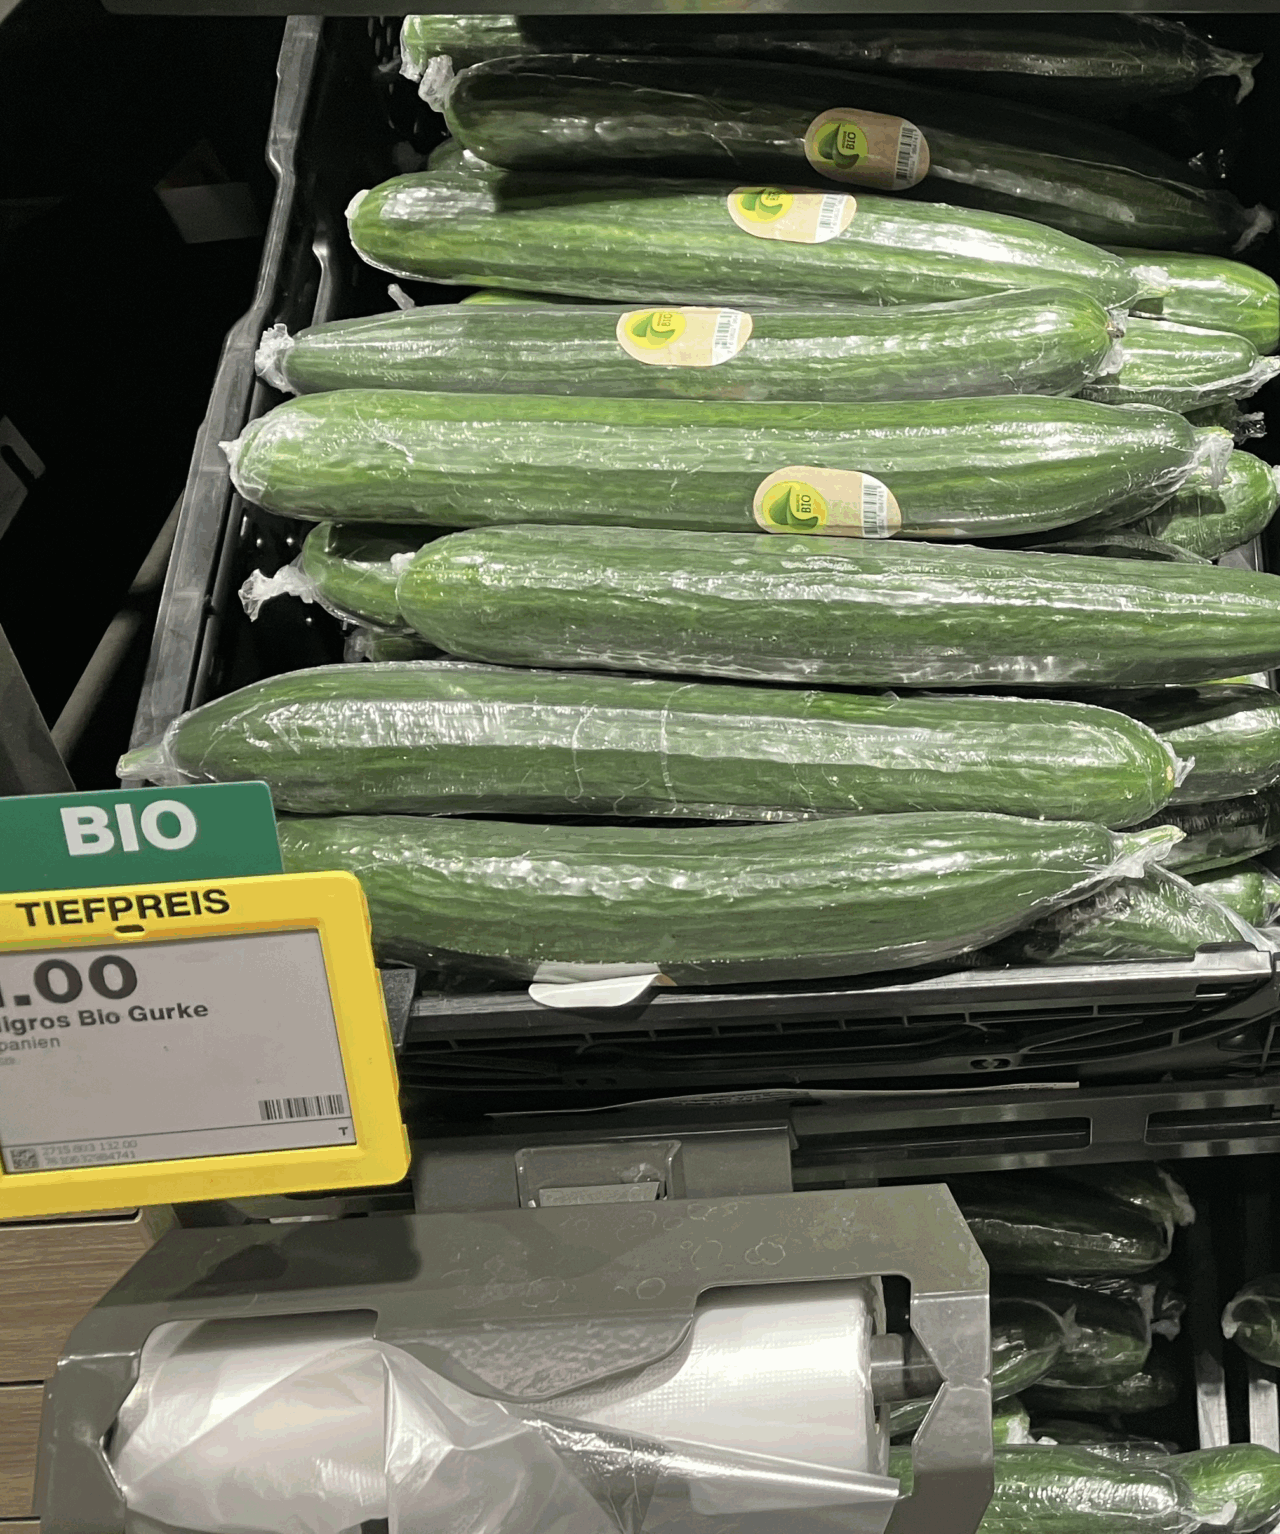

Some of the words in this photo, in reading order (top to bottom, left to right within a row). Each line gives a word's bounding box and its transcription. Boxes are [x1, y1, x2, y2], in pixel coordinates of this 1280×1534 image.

[846, 131, 856, 150] BIO
[801, 494, 811, 513] BIO
[59, 799, 198, 857] BIO
[16, 888, 231, 927] TIEFPREIS
[0, 954, 138, 1008] .00
[0, 1014, 71, 1036] igros
[78, 1008, 120, 1026] Bio
[128, 1002, 209, 1022] Gurke
[0, 1036, 61, 1055] panien
[338, 1126, 349, 1137] T
[100, 1140, 119, 1152] 132
